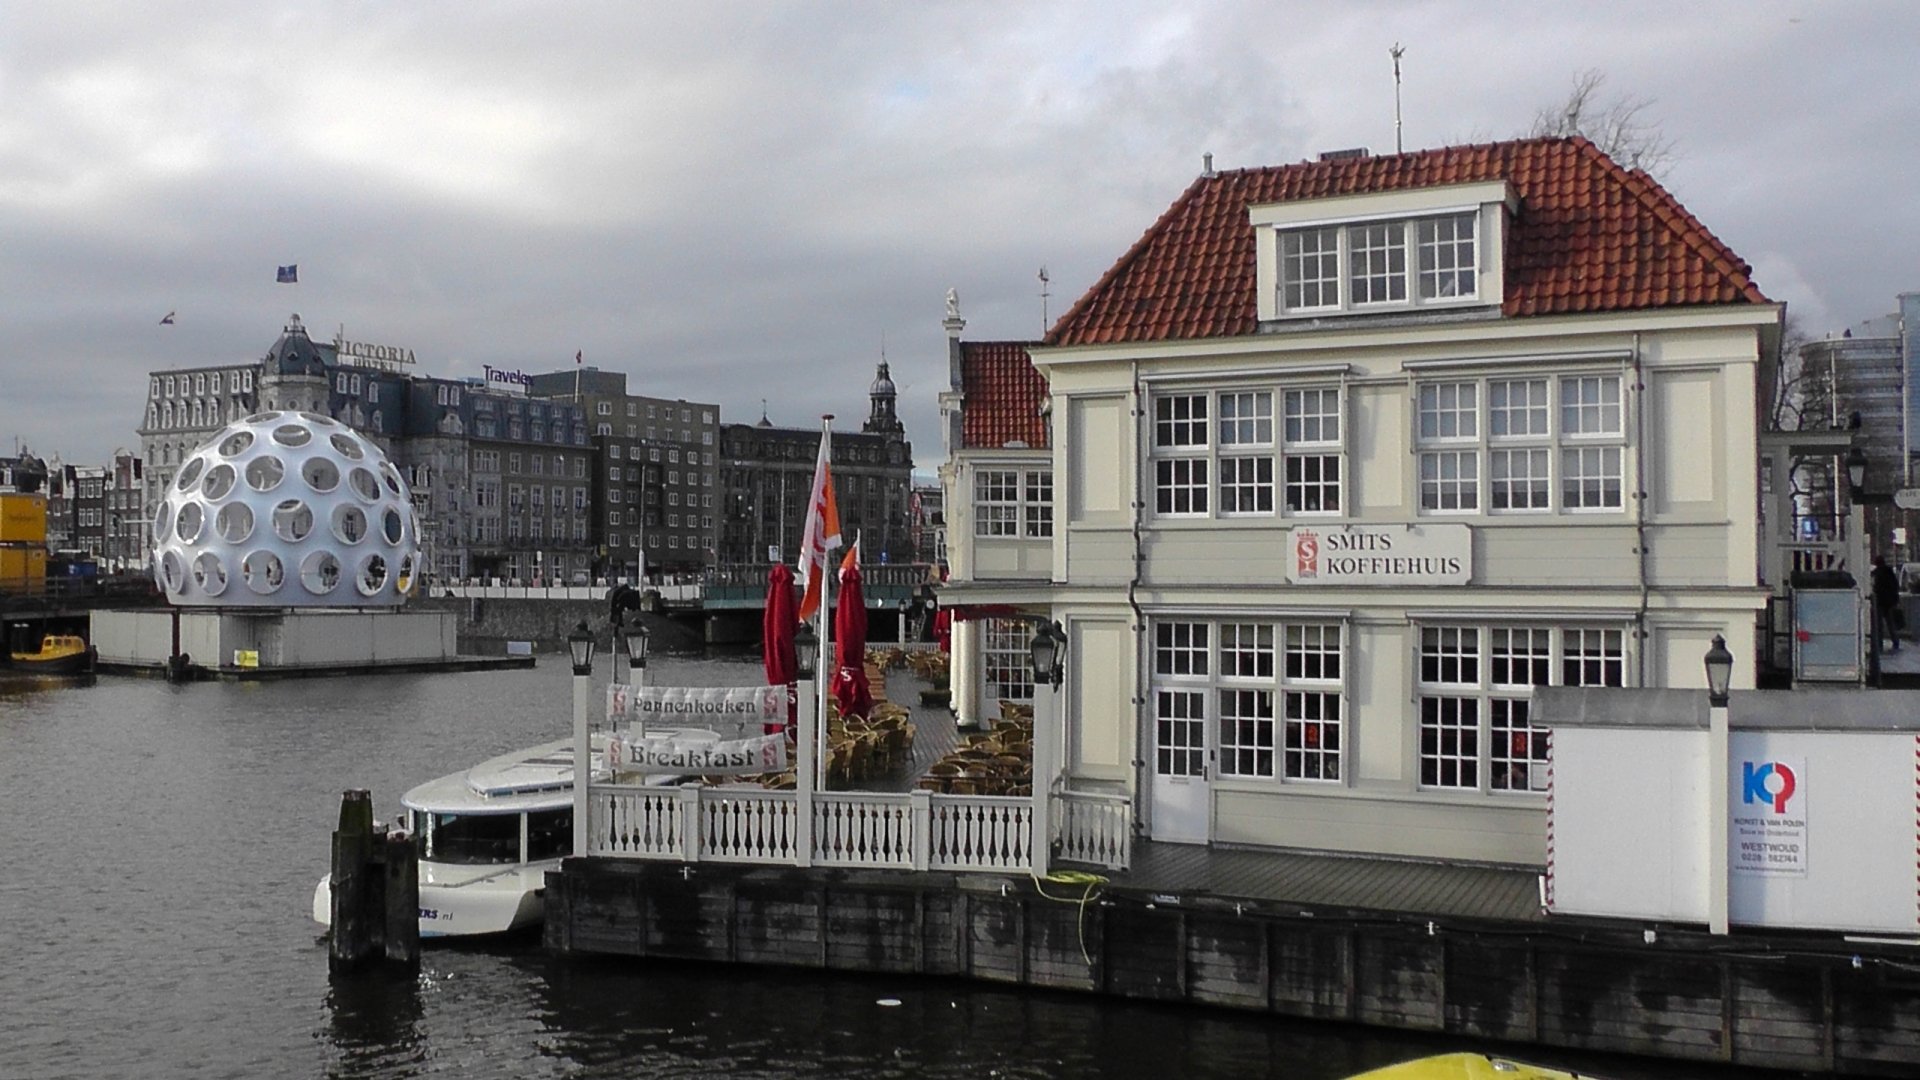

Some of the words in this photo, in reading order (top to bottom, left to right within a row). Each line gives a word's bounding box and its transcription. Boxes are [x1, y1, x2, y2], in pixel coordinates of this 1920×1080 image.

[332, 339, 417, 364] VICTORIA
[1327, 534, 1391, 551] SMITS
[1327, 557, 1461, 575] KOFFIEHUIS
[634, 698, 756, 713] Pannenkoeken
[630, 746, 754, 768] Breakfast
[1741, 842, 1799, 853] WESTWOUD
